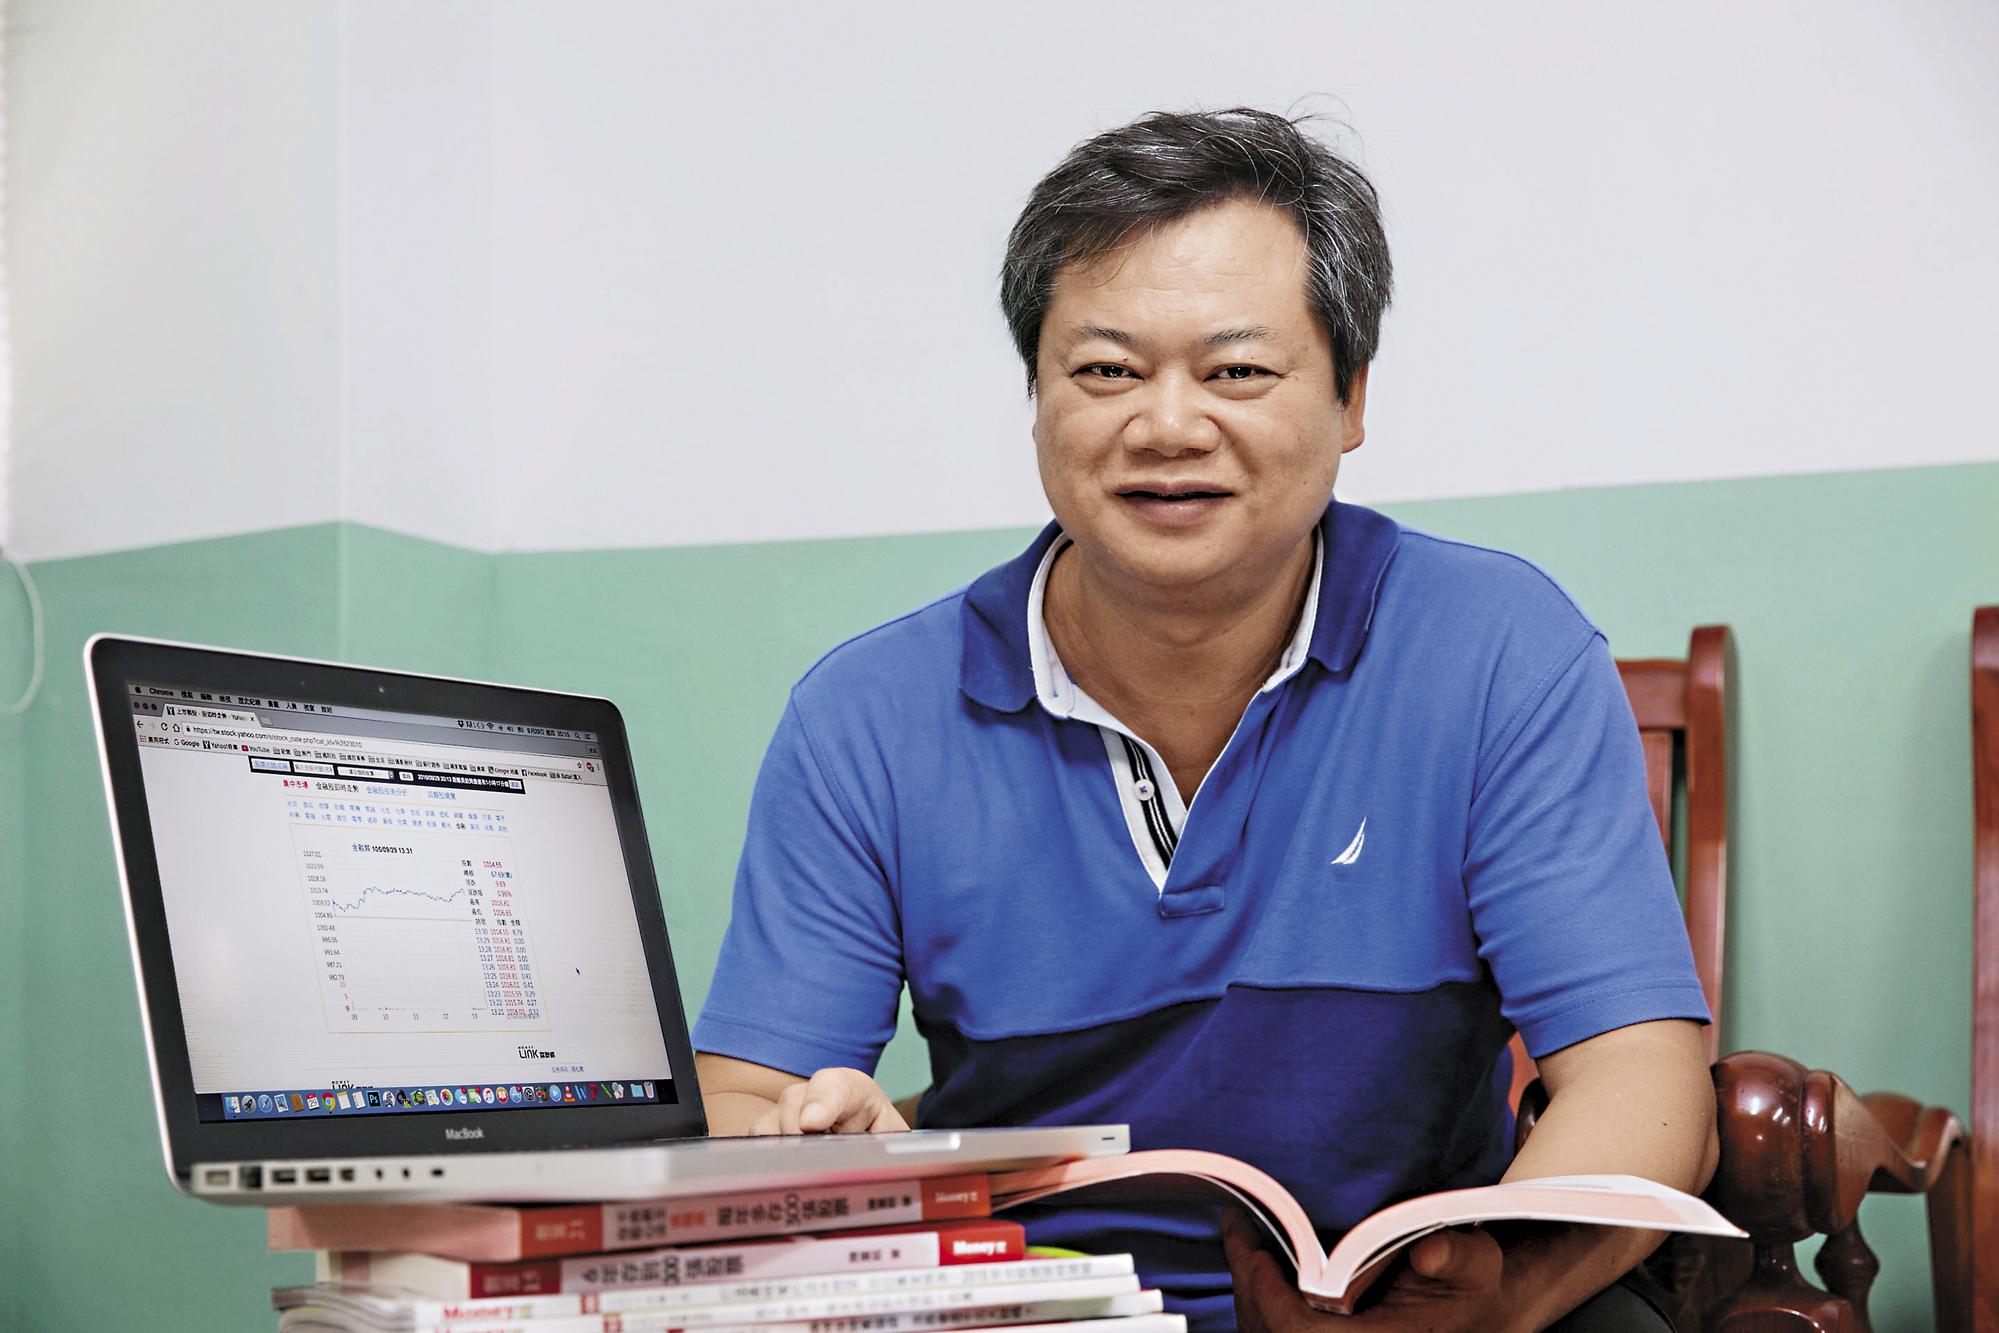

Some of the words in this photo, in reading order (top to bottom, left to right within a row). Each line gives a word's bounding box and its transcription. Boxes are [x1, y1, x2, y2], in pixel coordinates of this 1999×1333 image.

[149, 687, 173, 696] Chrome
[180, 738, 200, 747] Google
[248, 745, 270, 753] YouTube
[527, 770, 547, 778] Facebook
[282, 779, 309, 789] 集中市場
[371, 845, 397, 853] 105/09/29
[398, 846, 413, 854] 13:31
[519, 1049, 539, 1059] LINK
[369, 1094, 379, 1104] Ps
[445, 1127, 486, 1140] MacBook
